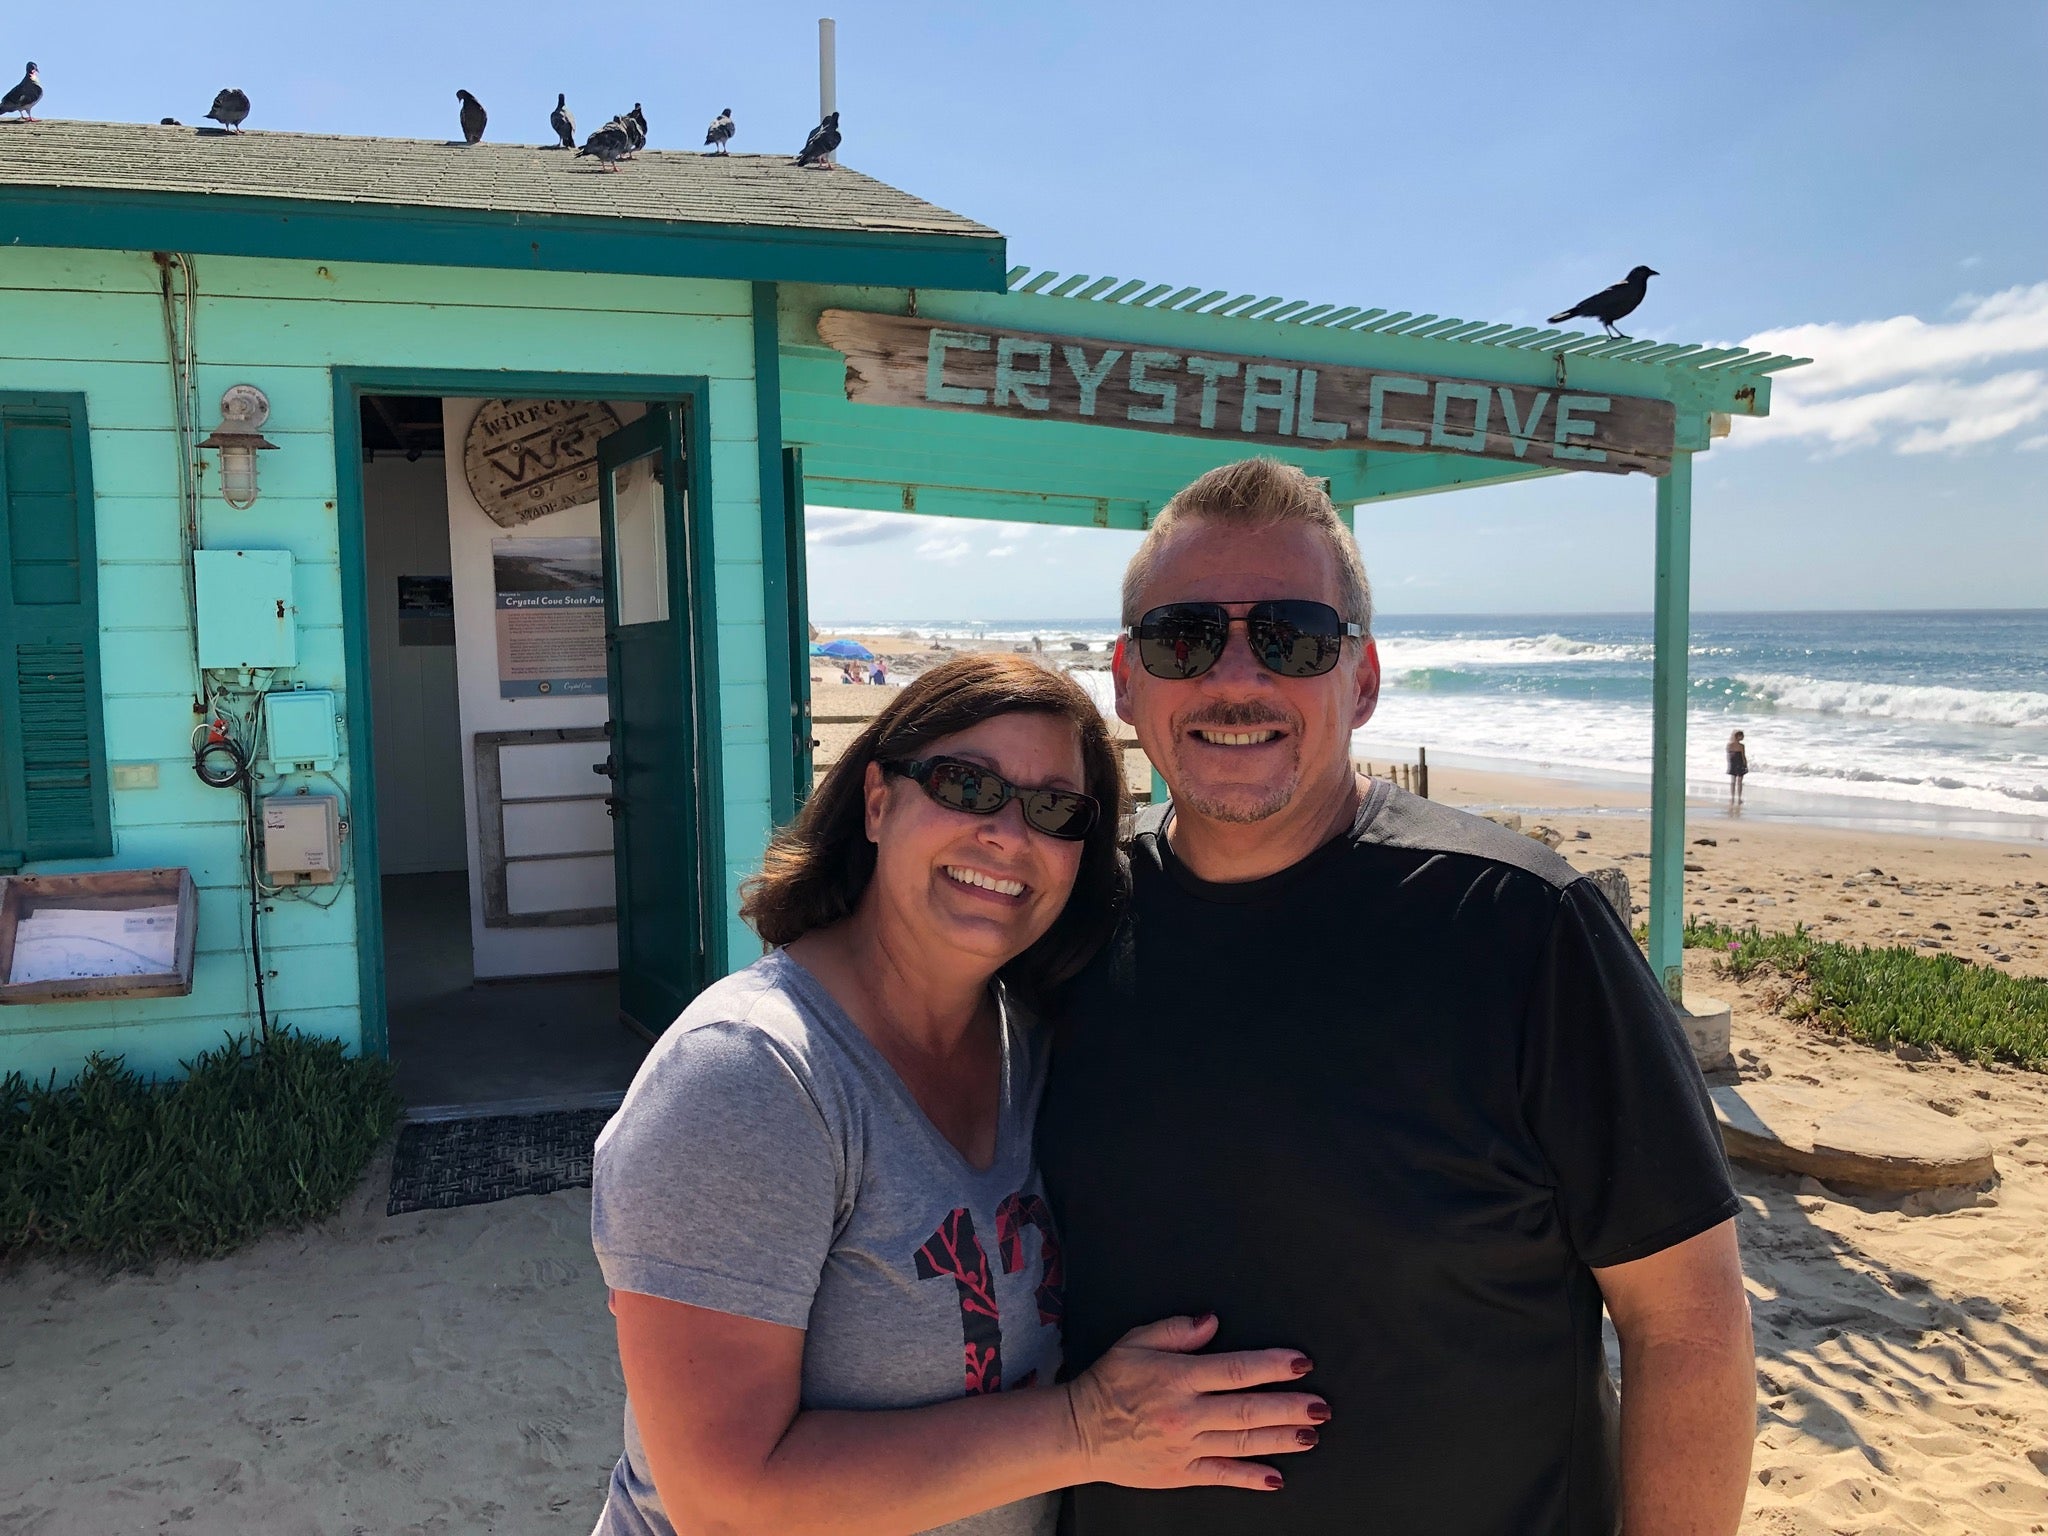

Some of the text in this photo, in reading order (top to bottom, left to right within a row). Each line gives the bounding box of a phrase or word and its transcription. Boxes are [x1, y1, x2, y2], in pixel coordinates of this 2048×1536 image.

[925, 327, 1611, 463] CRYSTAL COVE
[505, 595, 604, 608] Crystal Cove State Par
